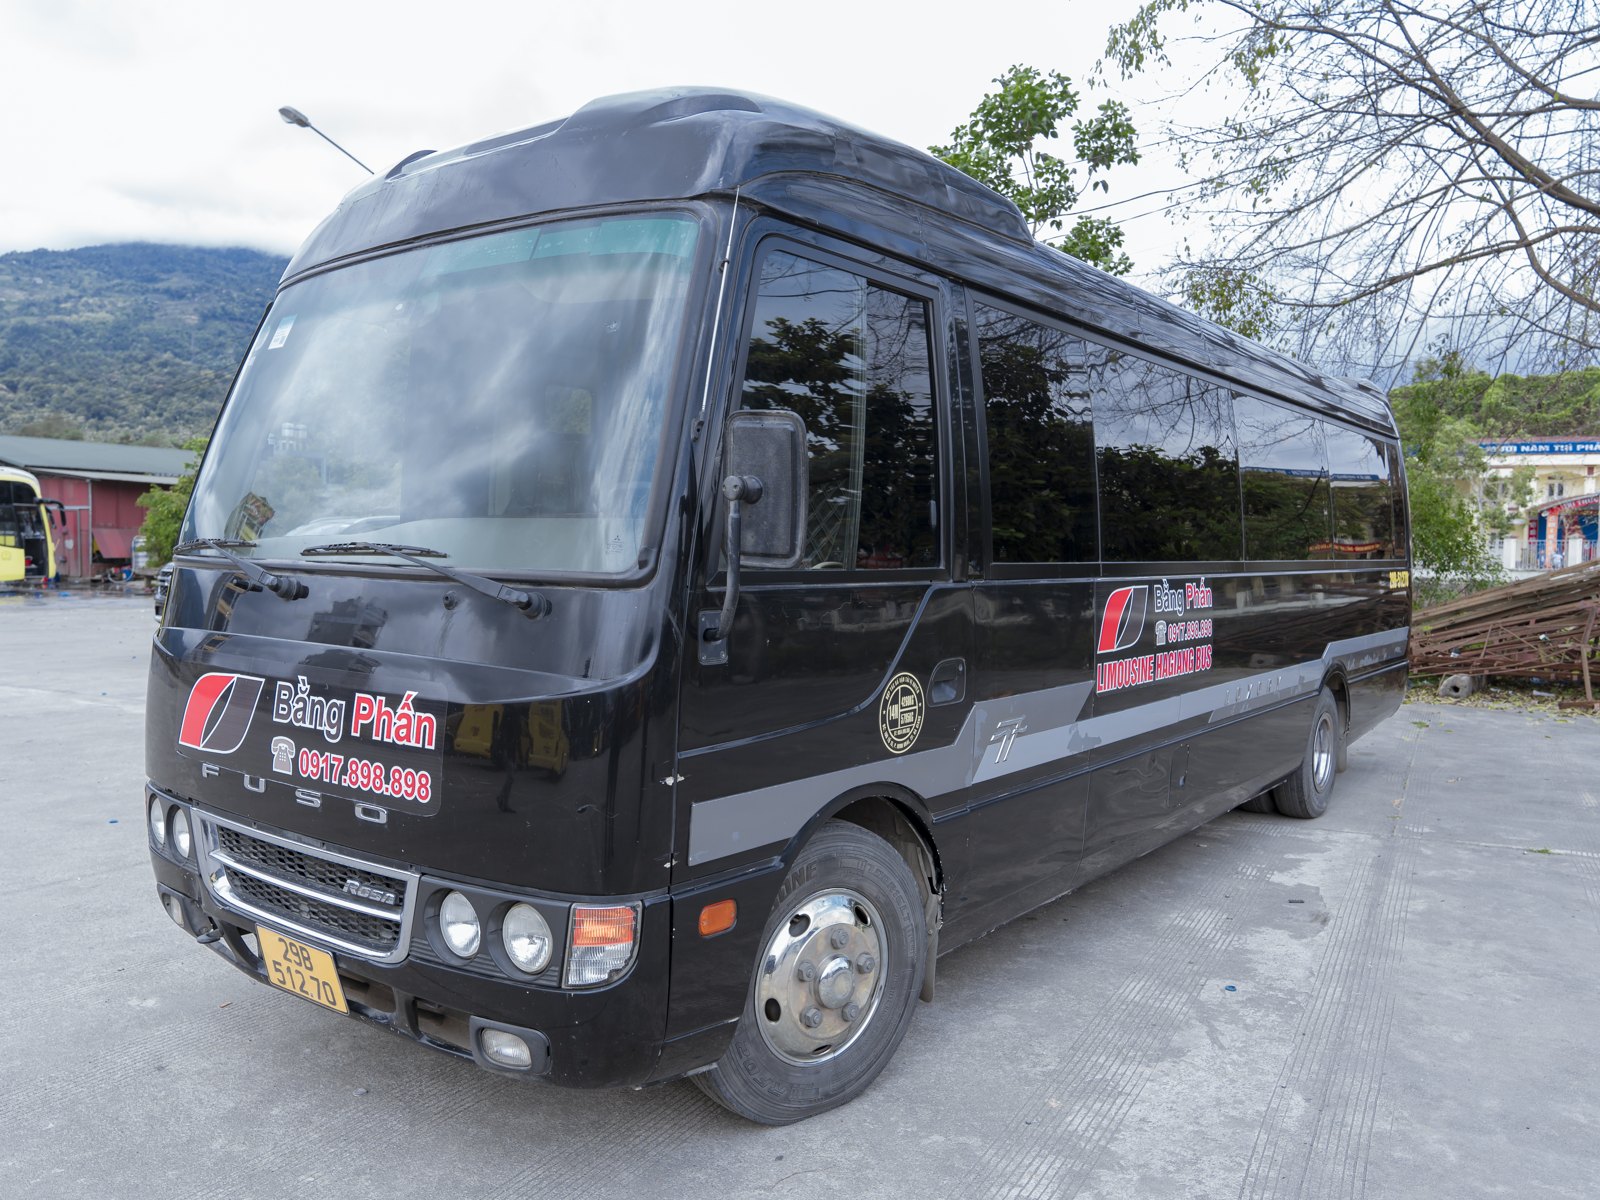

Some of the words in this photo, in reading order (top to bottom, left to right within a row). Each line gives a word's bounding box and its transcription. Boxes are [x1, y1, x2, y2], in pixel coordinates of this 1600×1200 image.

[1154, 579, 1184, 616] Bằng
[1168, 619, 1212, 643] 0917.898.898
[1096, 654, 1155, 693] LIMOUSINE
[1155, 647, 1195, 680] HAGIANG
[1195, 644, 1212, 672] BUS
[273, 675, 345, 743] Bằng
[350, 691, 436, 750] Phấn
[202, 762, 388, 824] FUSO
[299, 748, 431, 803] 0917.898.898
[278, 937, 313, 971] 29B
[272, 960, 337, 1006] 512.70
